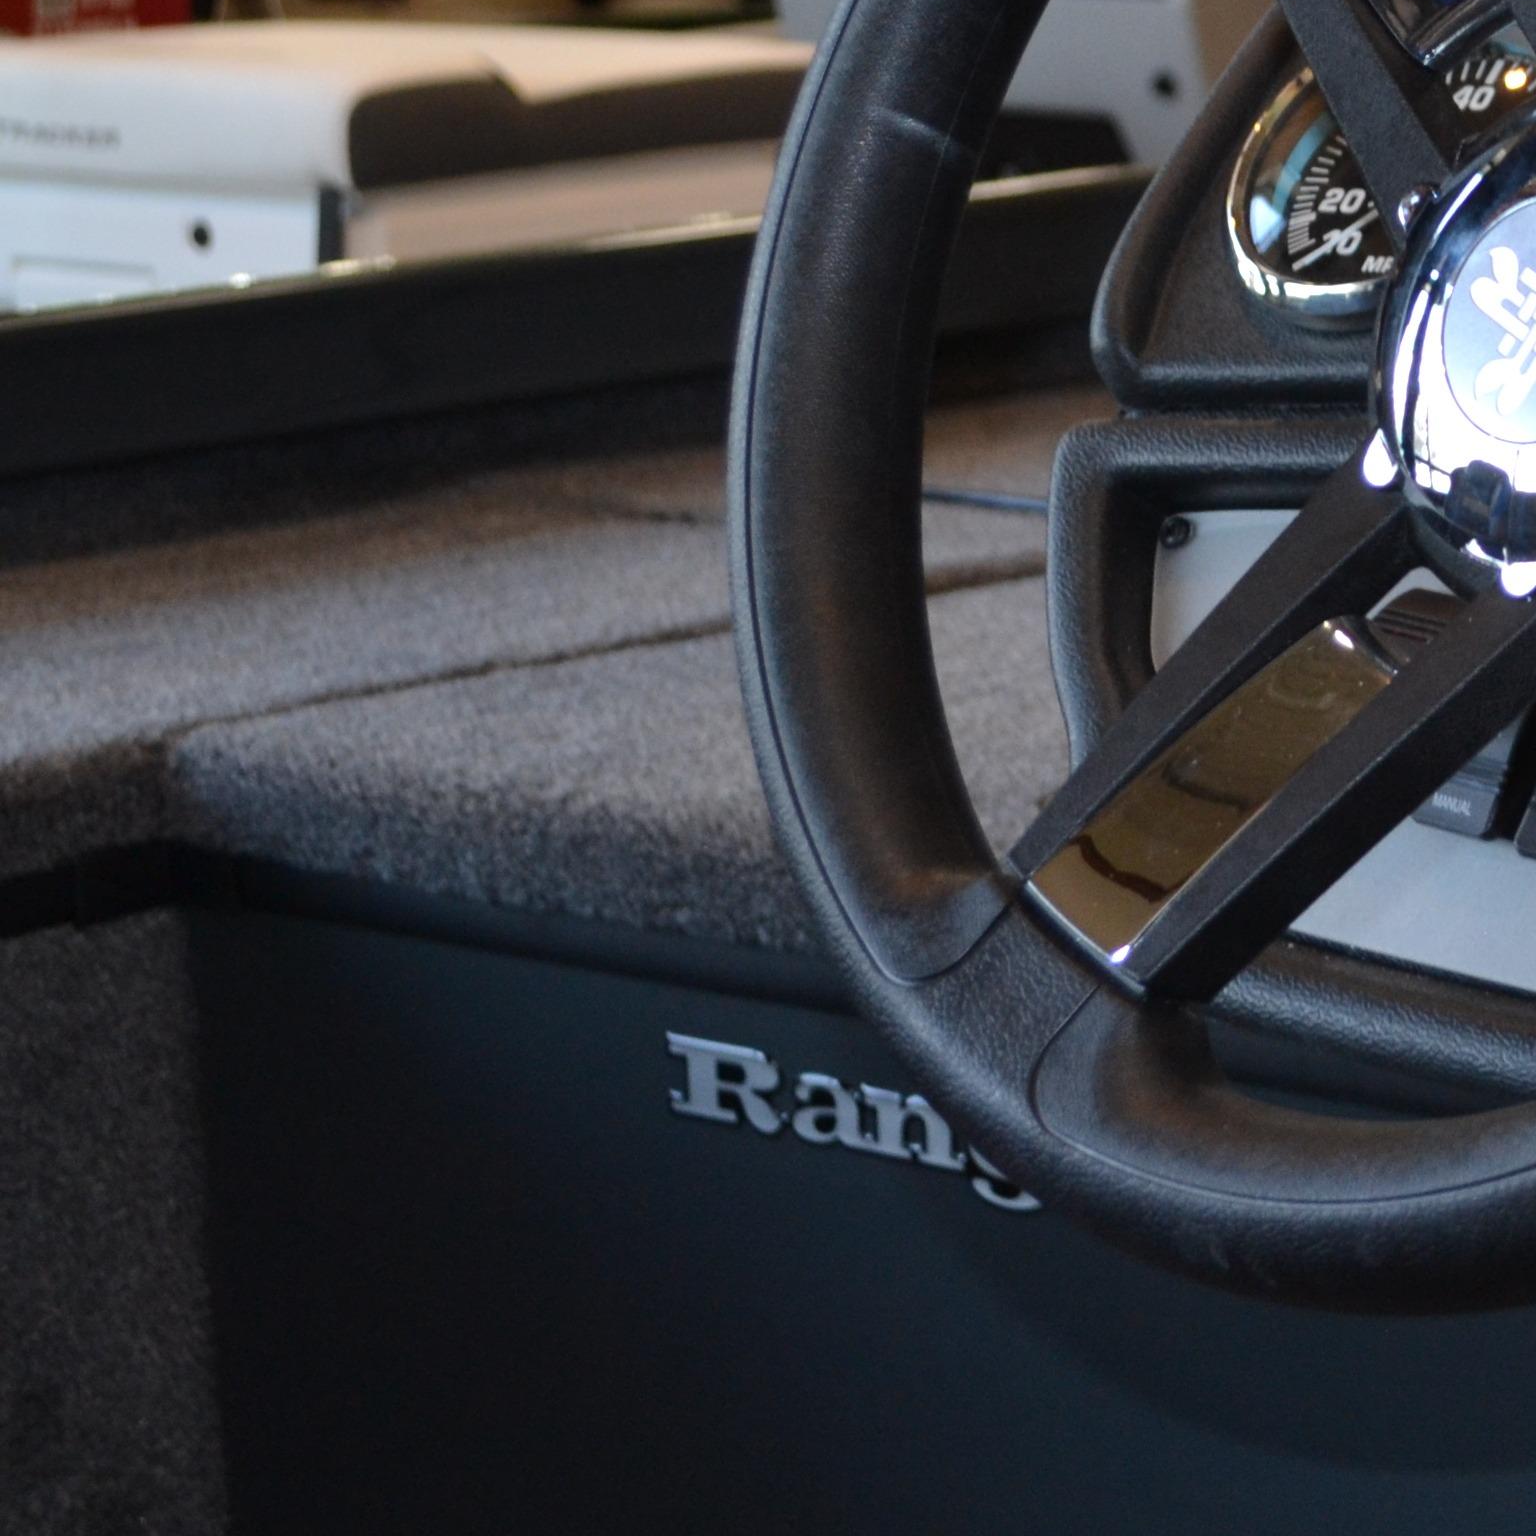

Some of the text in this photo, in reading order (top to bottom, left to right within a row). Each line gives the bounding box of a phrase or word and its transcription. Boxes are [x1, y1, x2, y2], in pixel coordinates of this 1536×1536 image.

[1453, 85, 1495, 111] 40
[1318, 188, 1366, 213] 20
[1431, 792, 1472, 817] MANUAL
